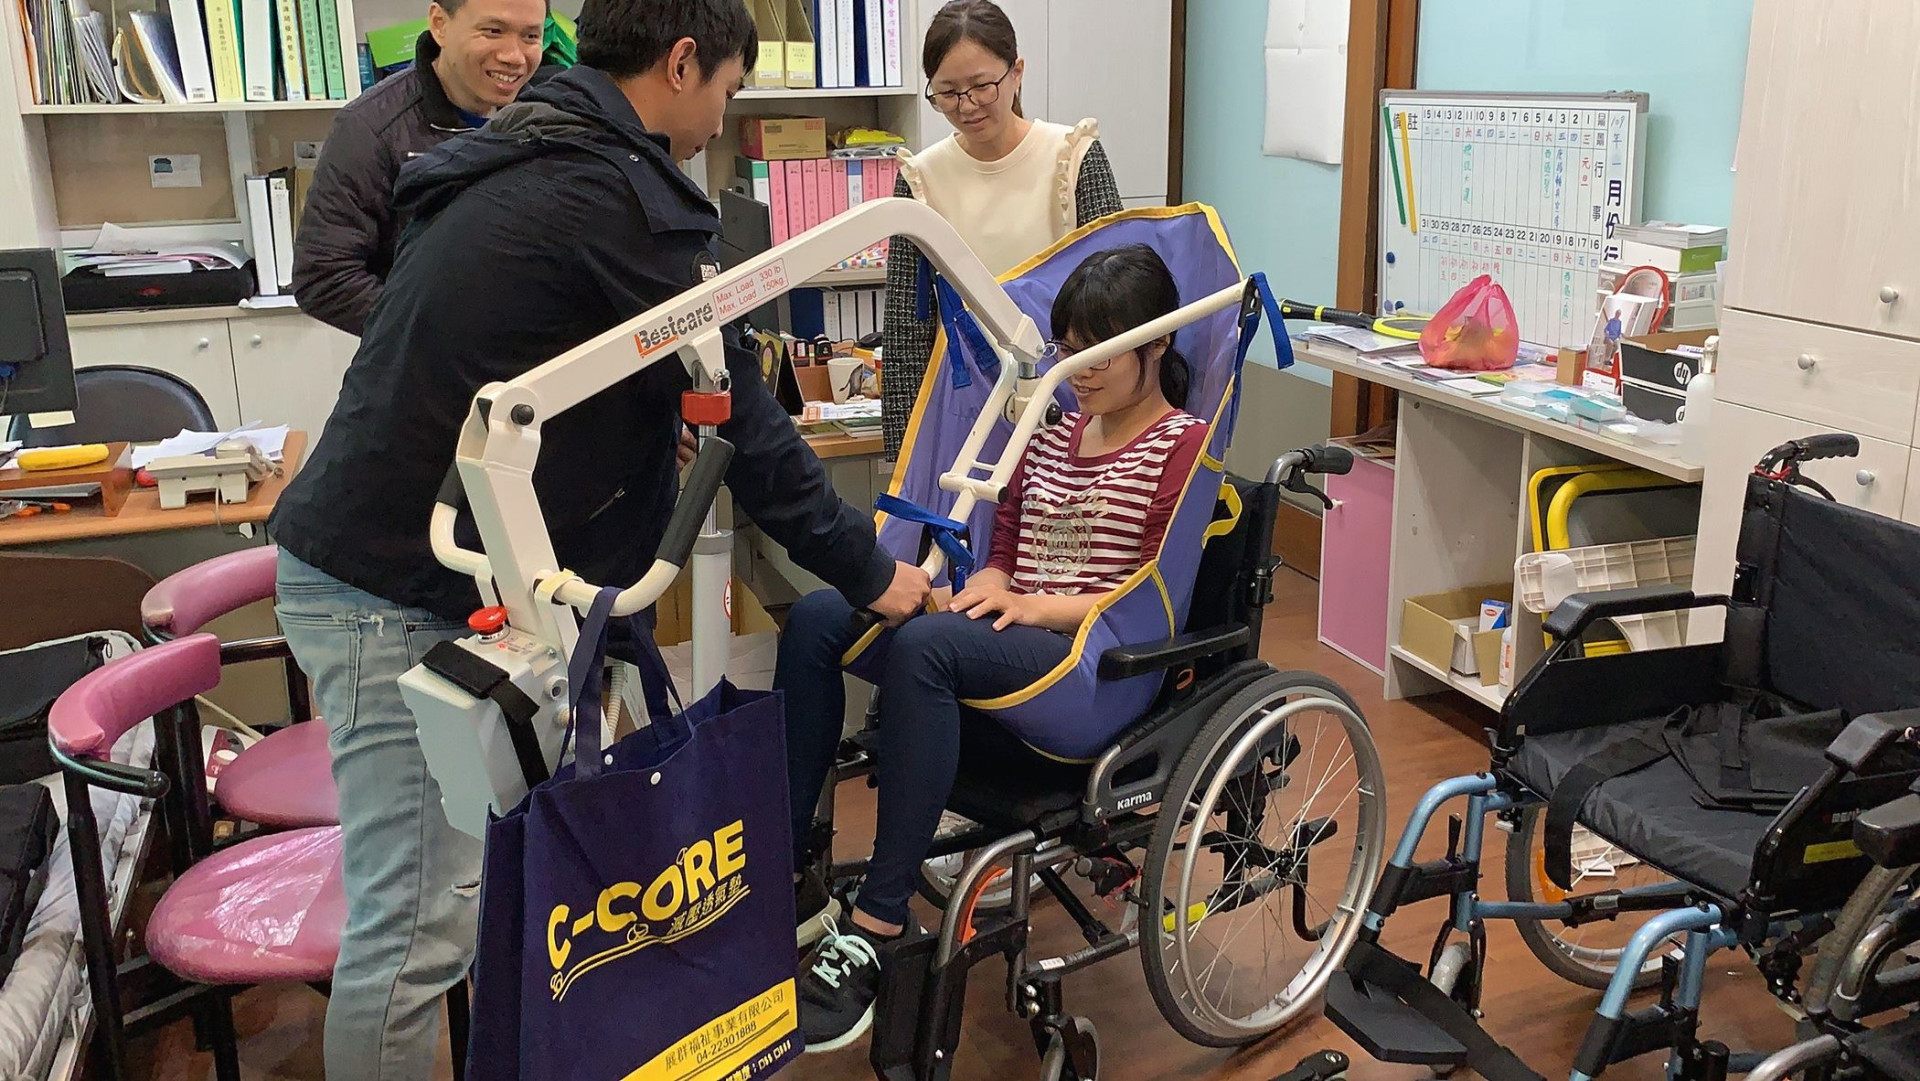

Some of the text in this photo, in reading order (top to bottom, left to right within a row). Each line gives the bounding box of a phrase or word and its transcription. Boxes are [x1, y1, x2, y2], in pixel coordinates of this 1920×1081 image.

[1424, 110, 1590, 124] 15 14 13 12 11 10 9 8 7 6 5 4 3 2 1
[1422, 219, 1600, 250] 31 30 29 28 27 26 25 24 23 22 21 20 19 18 17 16
[735, 277, 754, 294] Load
[759, 268, 773, 282] 330
[738, 289, 757, 305] Load
[635, 302, 714, 356] Bestcare
[547, 819, 746, 970] C-CORE
[665, 988, 784, 1072] 展群福祉事業有限公司
[696, 1021, 757, 1064] 04-22301888
